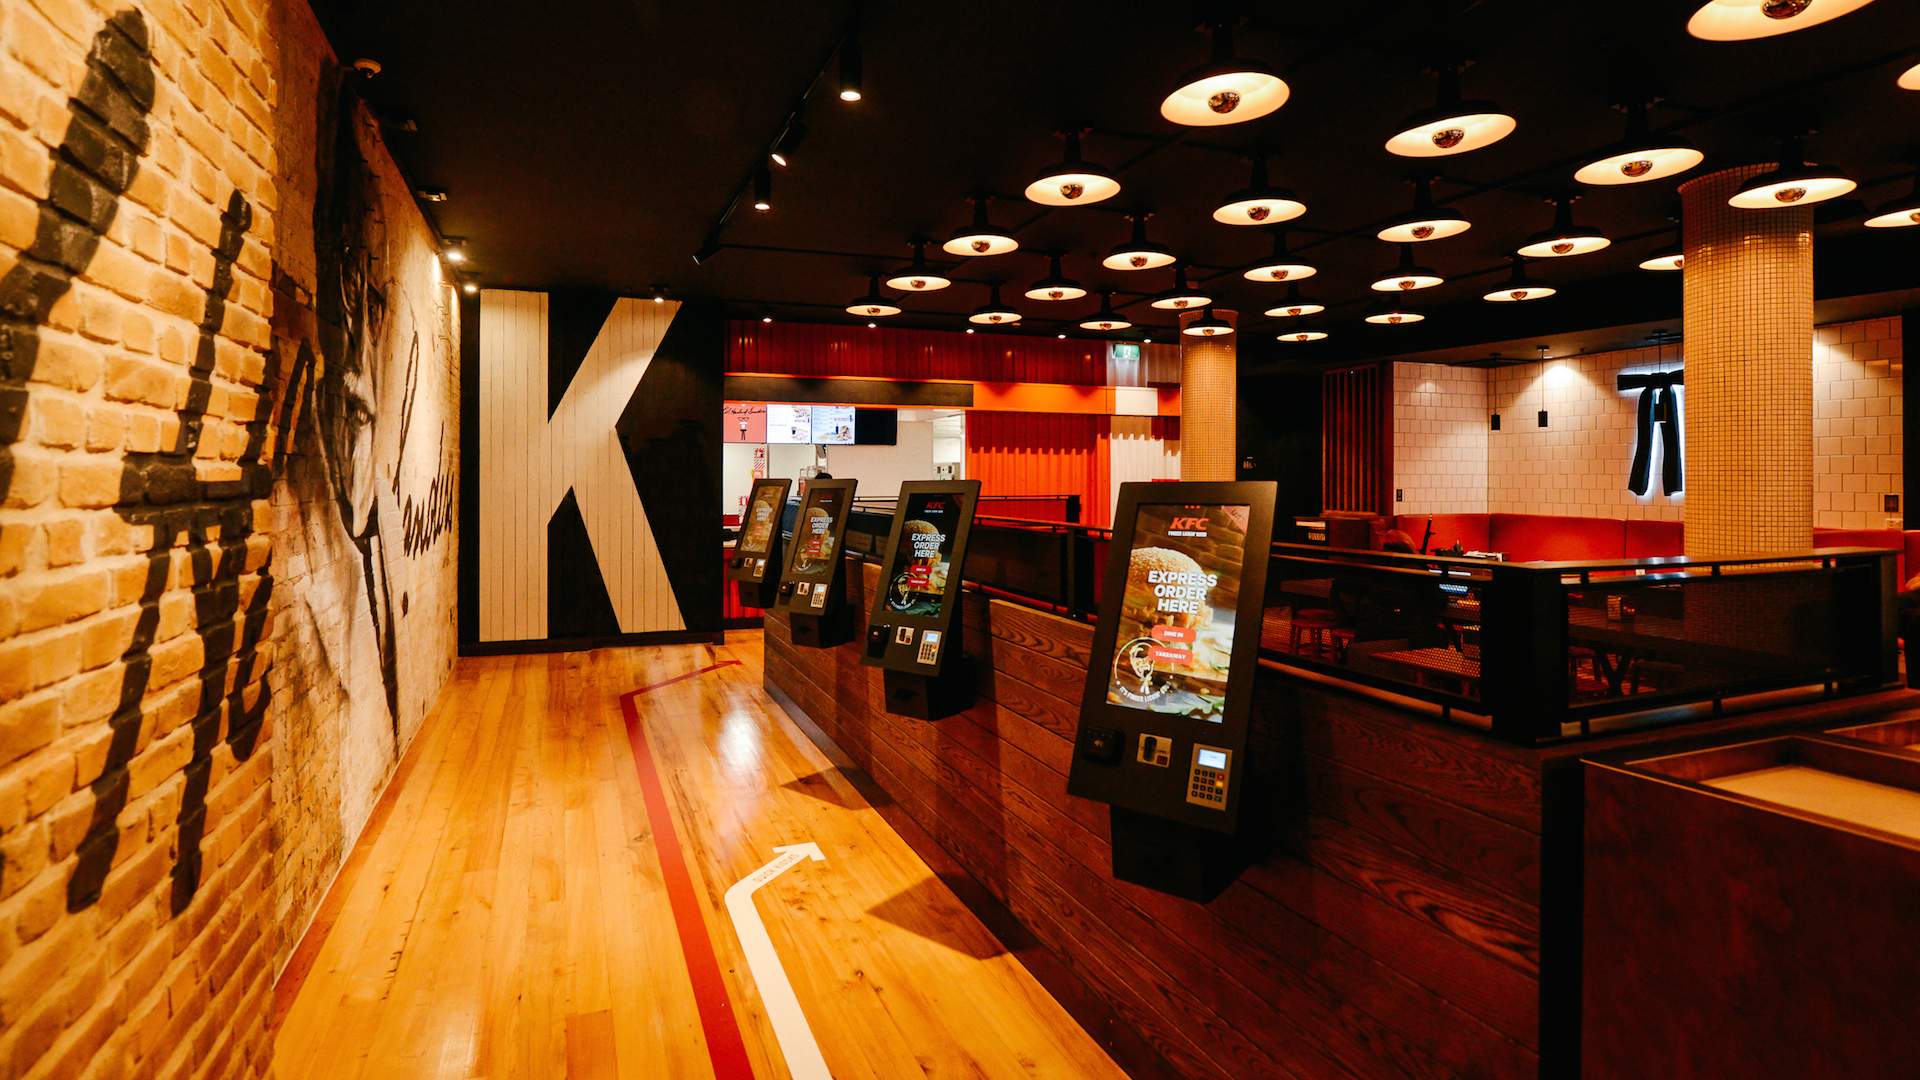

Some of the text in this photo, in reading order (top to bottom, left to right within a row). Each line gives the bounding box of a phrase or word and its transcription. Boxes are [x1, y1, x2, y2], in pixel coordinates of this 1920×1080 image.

[480, 289, 687, 642] K
[1170, 517, 1210, 530] KFC
[912, 533, 945, 542] EXPRESS
[914, 541, 940, 550] ORDER
[914, 549, 935, 558] HERE
[1148, 570, 1218, 587] EXPRESS
[1154, 584, 1207, 600] ORDER
[1157, 598, 1199, 614] HERE
